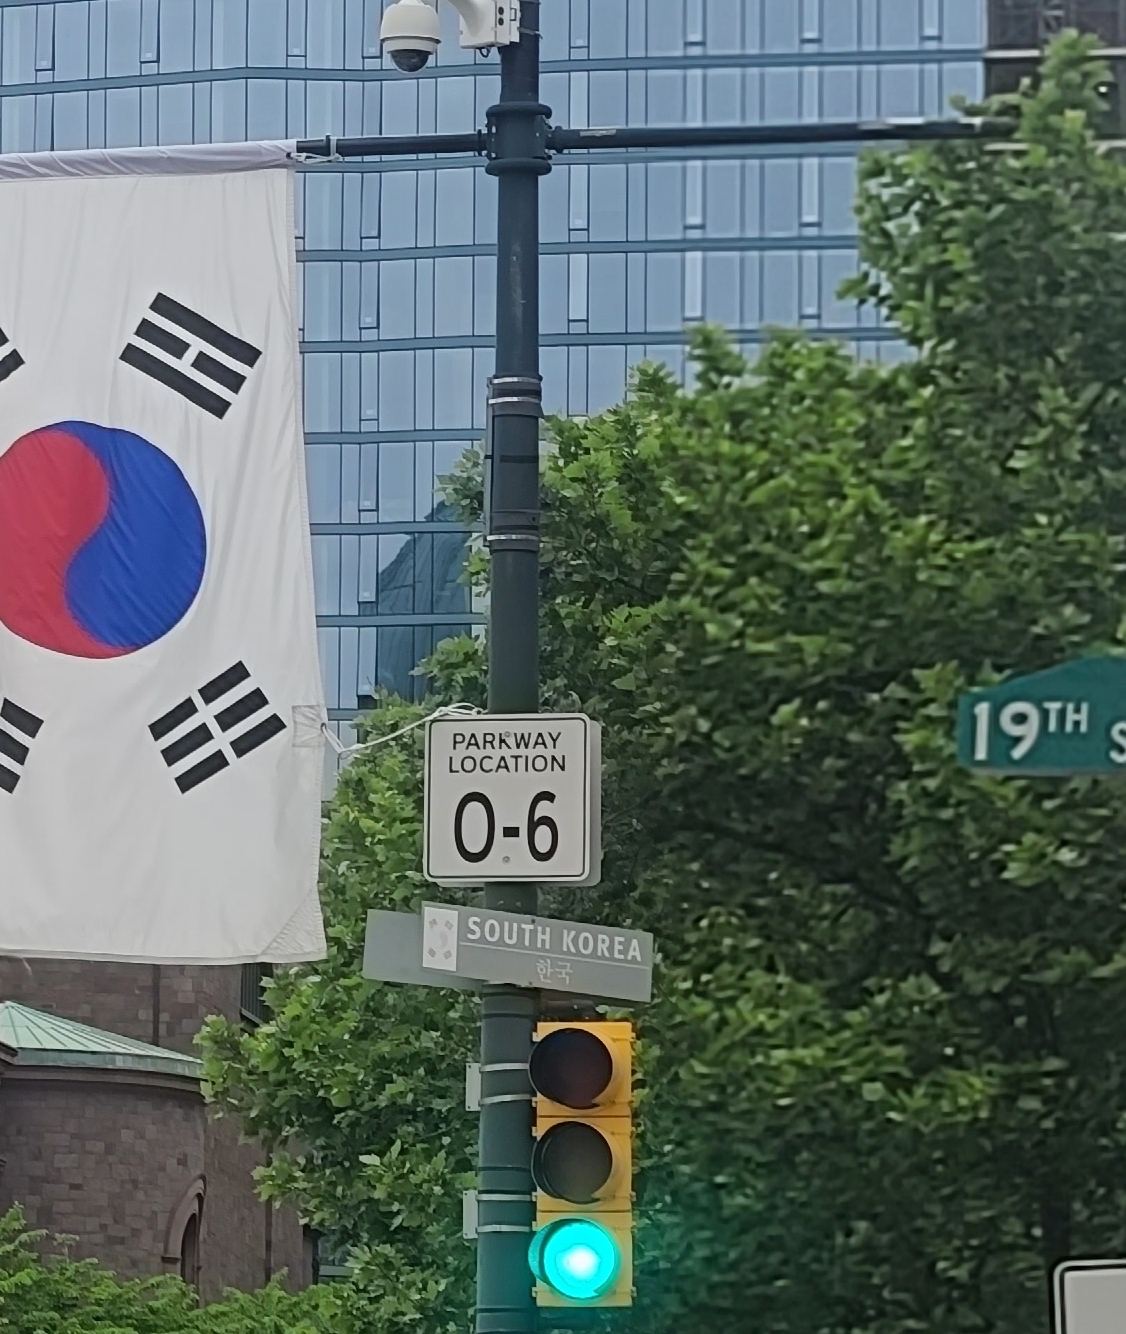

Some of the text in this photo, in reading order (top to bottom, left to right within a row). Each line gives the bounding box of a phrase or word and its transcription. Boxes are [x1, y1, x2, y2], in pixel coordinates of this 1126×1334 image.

[452, 730, 563, 752] PARKWAY
[973, 700, 1090, 762] 19TH
[448, 754, 567, 774] LOCATION
[466, 916, 643, 963] SOUTH KOREA
[535, 958, 574, 986] 한국
